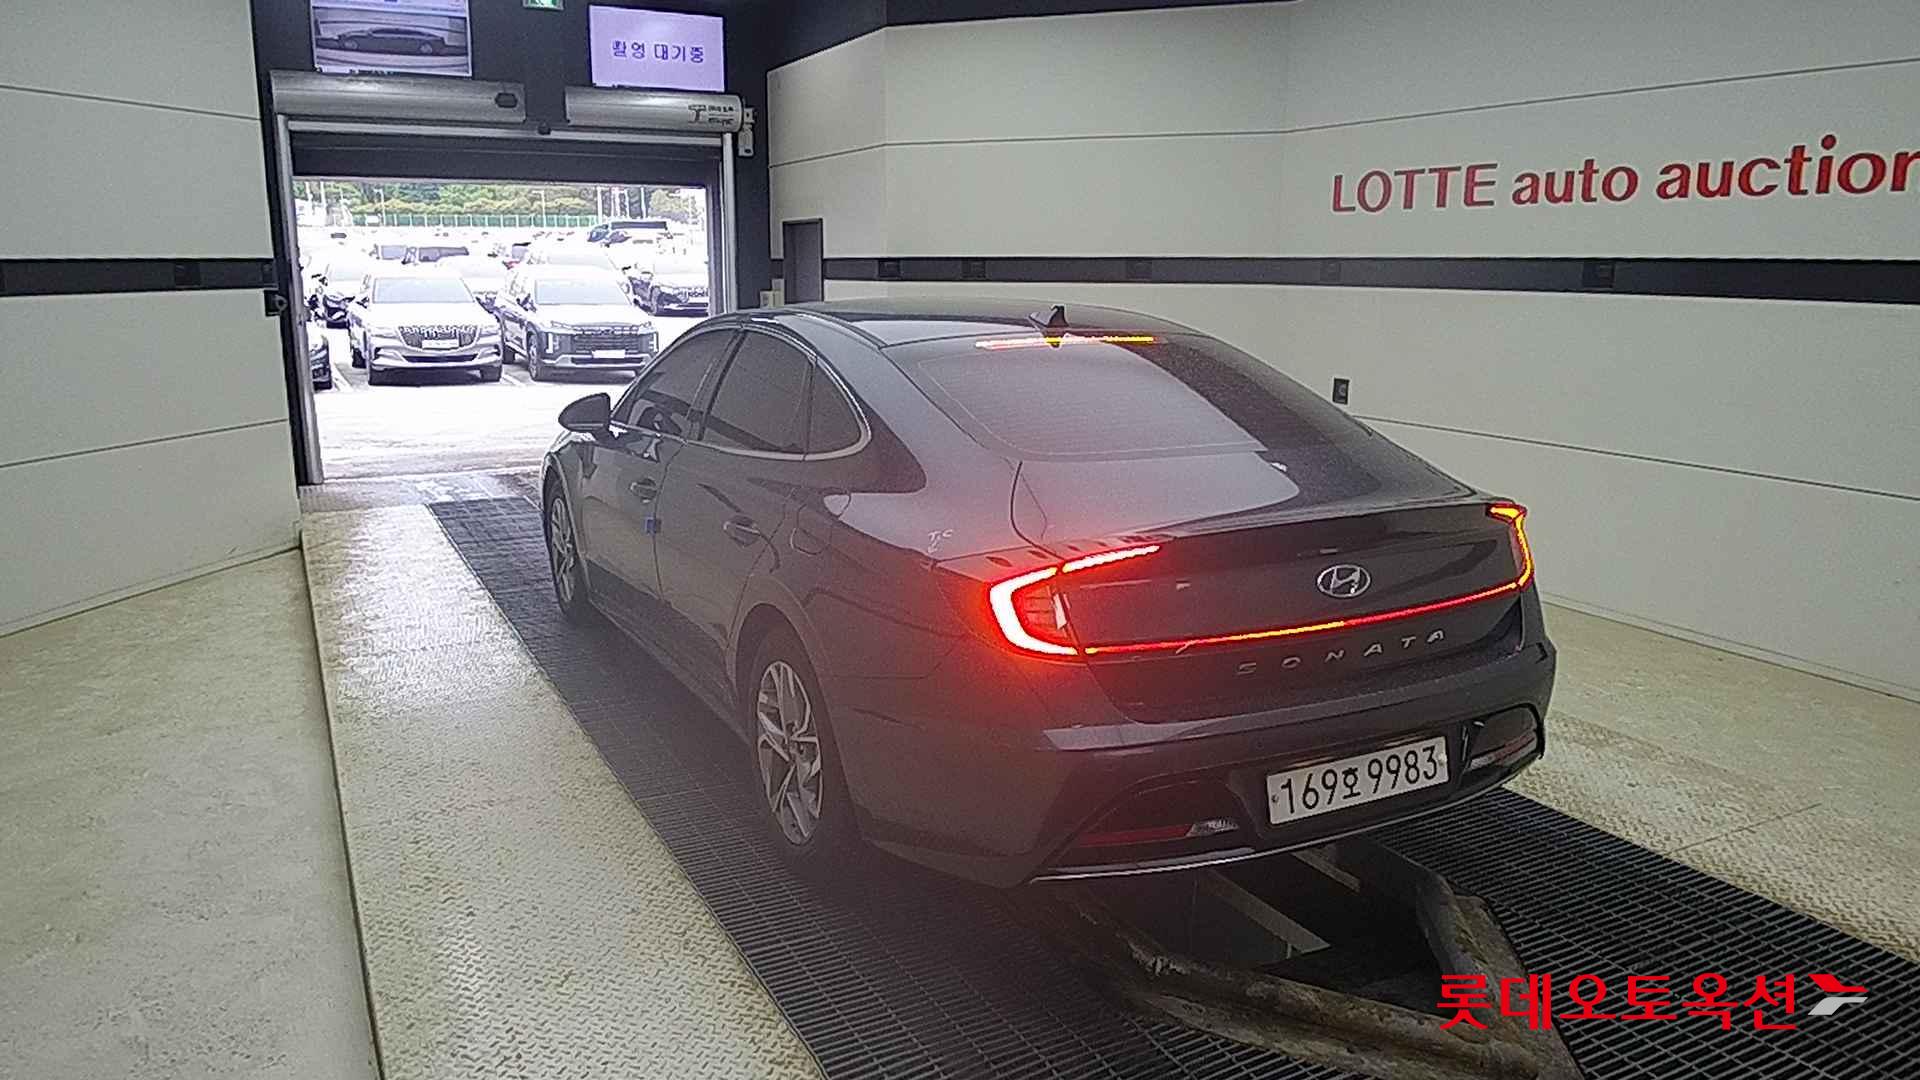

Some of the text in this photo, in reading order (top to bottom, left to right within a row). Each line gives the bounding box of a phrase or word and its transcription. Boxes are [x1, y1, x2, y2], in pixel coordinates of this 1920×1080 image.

[654, 43, 704, 63] 대기중
[1332, 163, 1498, 213] LOTTE
[1512, 159, 1638, 205] auto
[1236, 630, 1445, 676] SONATA
[1280, 745, 1437, 814] 169호 9983
